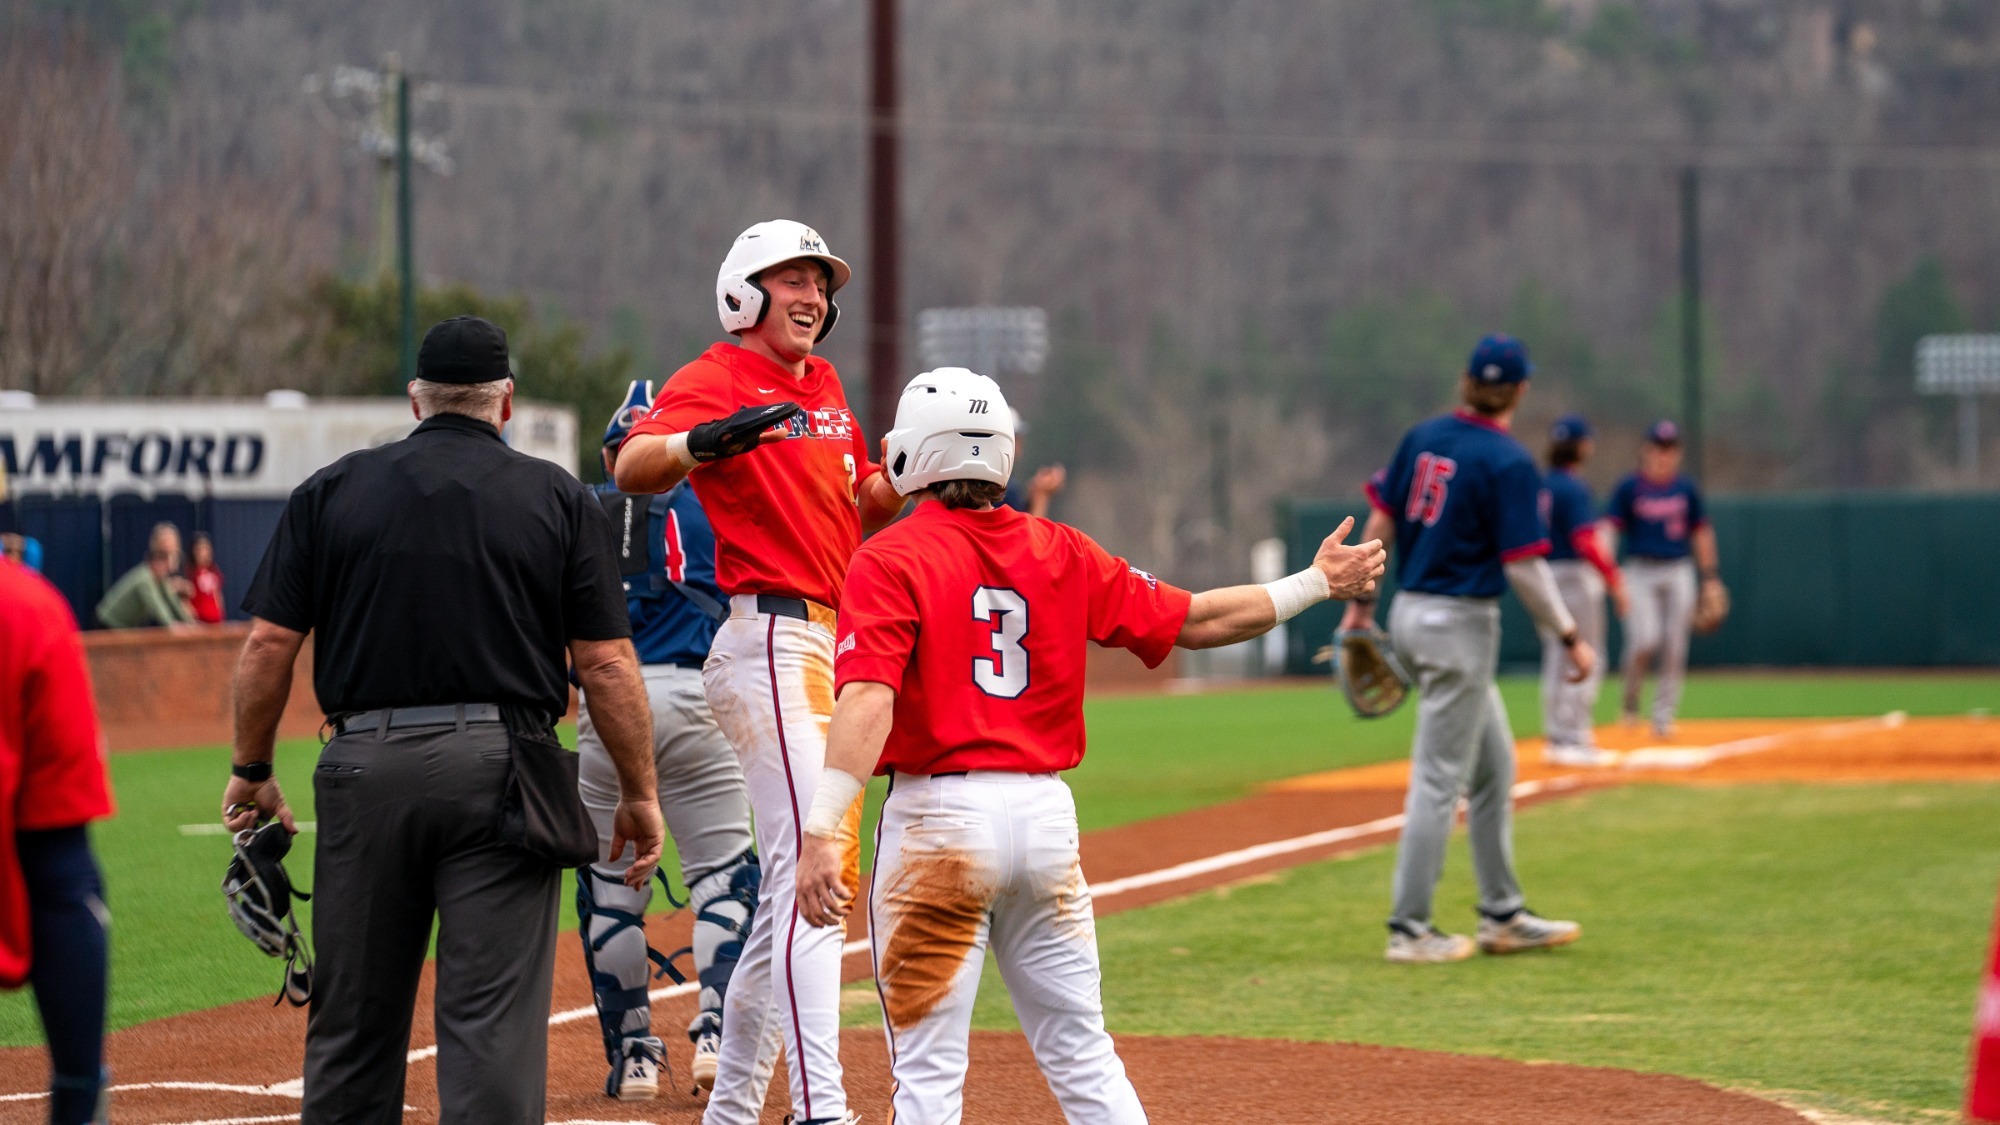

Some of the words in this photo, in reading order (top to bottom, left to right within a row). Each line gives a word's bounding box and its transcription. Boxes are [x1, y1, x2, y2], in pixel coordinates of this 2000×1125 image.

[971, 445, 980, 457] 3
[1405, 450, 1458, 529] 15
[971, 583, 1031, 700] 3
